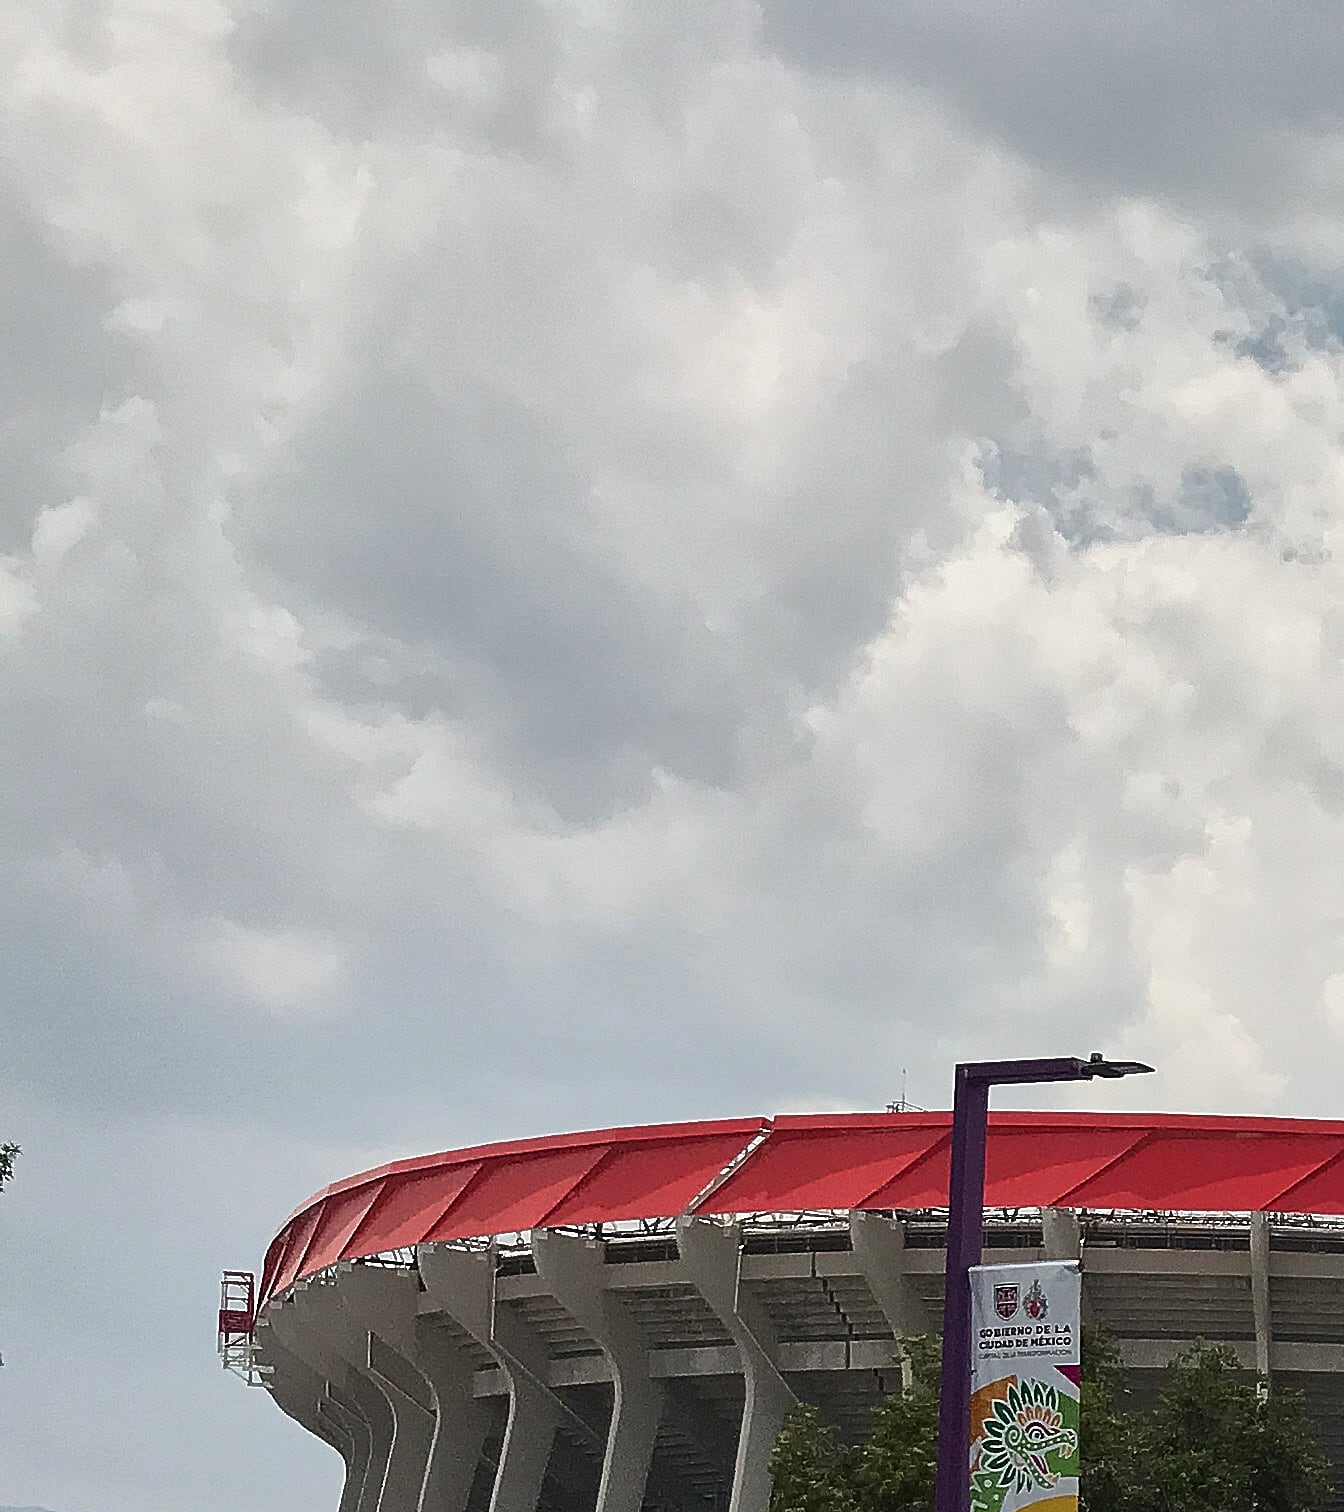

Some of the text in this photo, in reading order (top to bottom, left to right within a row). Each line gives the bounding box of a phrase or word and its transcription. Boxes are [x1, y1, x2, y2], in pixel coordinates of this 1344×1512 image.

[980, 1324, 1071, 1338] GOBIERNO DE LA
[979, 1340, 1013, 1350] CIUDAD
[1016, 1339, 1028, 1347] DE
